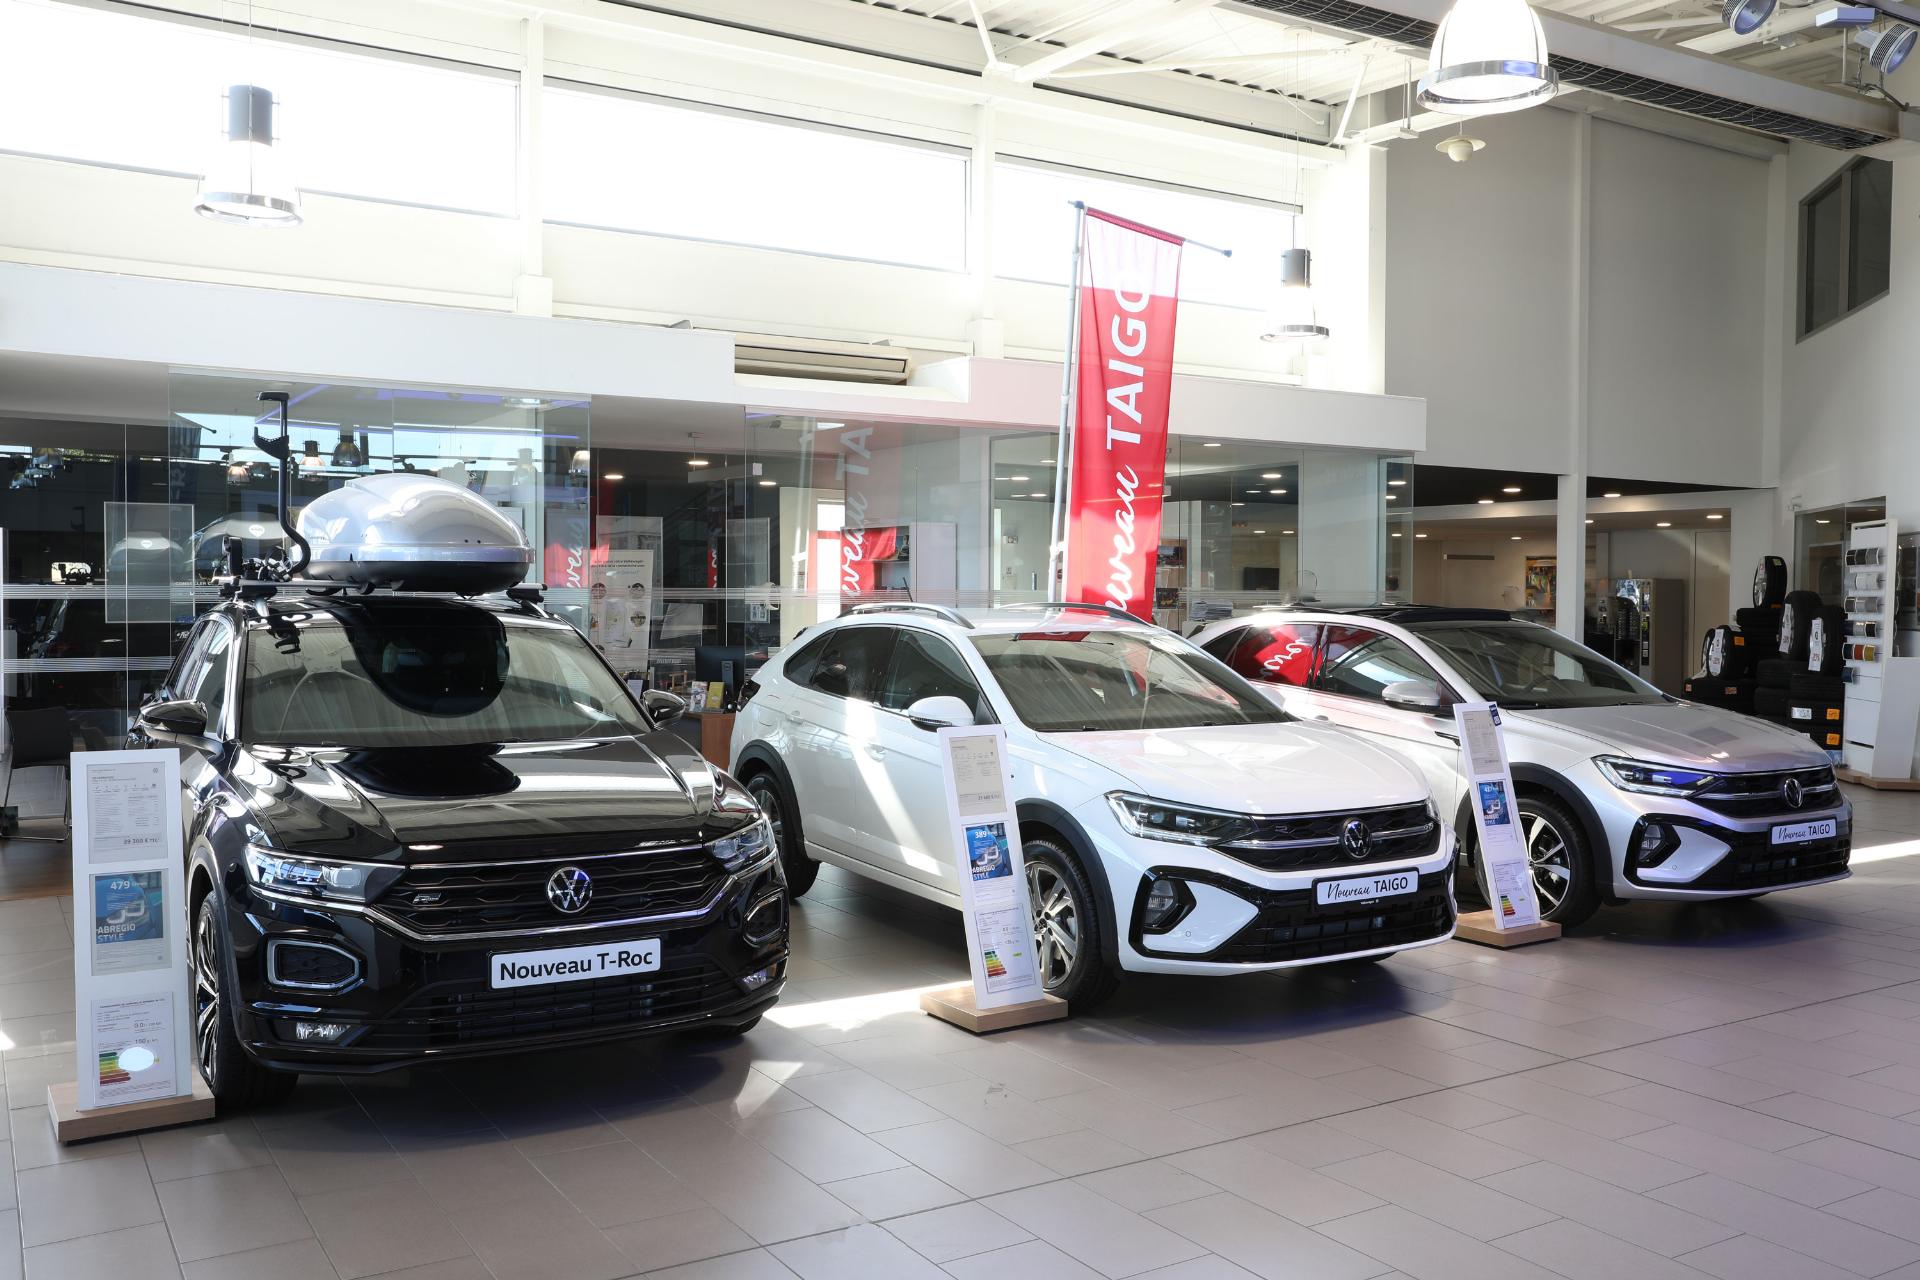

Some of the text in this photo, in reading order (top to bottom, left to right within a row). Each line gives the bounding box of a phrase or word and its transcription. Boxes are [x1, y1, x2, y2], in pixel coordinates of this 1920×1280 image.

[1808, 824, 1831, 836] TAIGO
[110, 880, 130, 890] 479
[1327, 877, 1408, 900] Nouveau TAIGO
[97, 923, 136, 935] ABREGIO
[500, 950, 653, 981] Nouveau T-Roc
